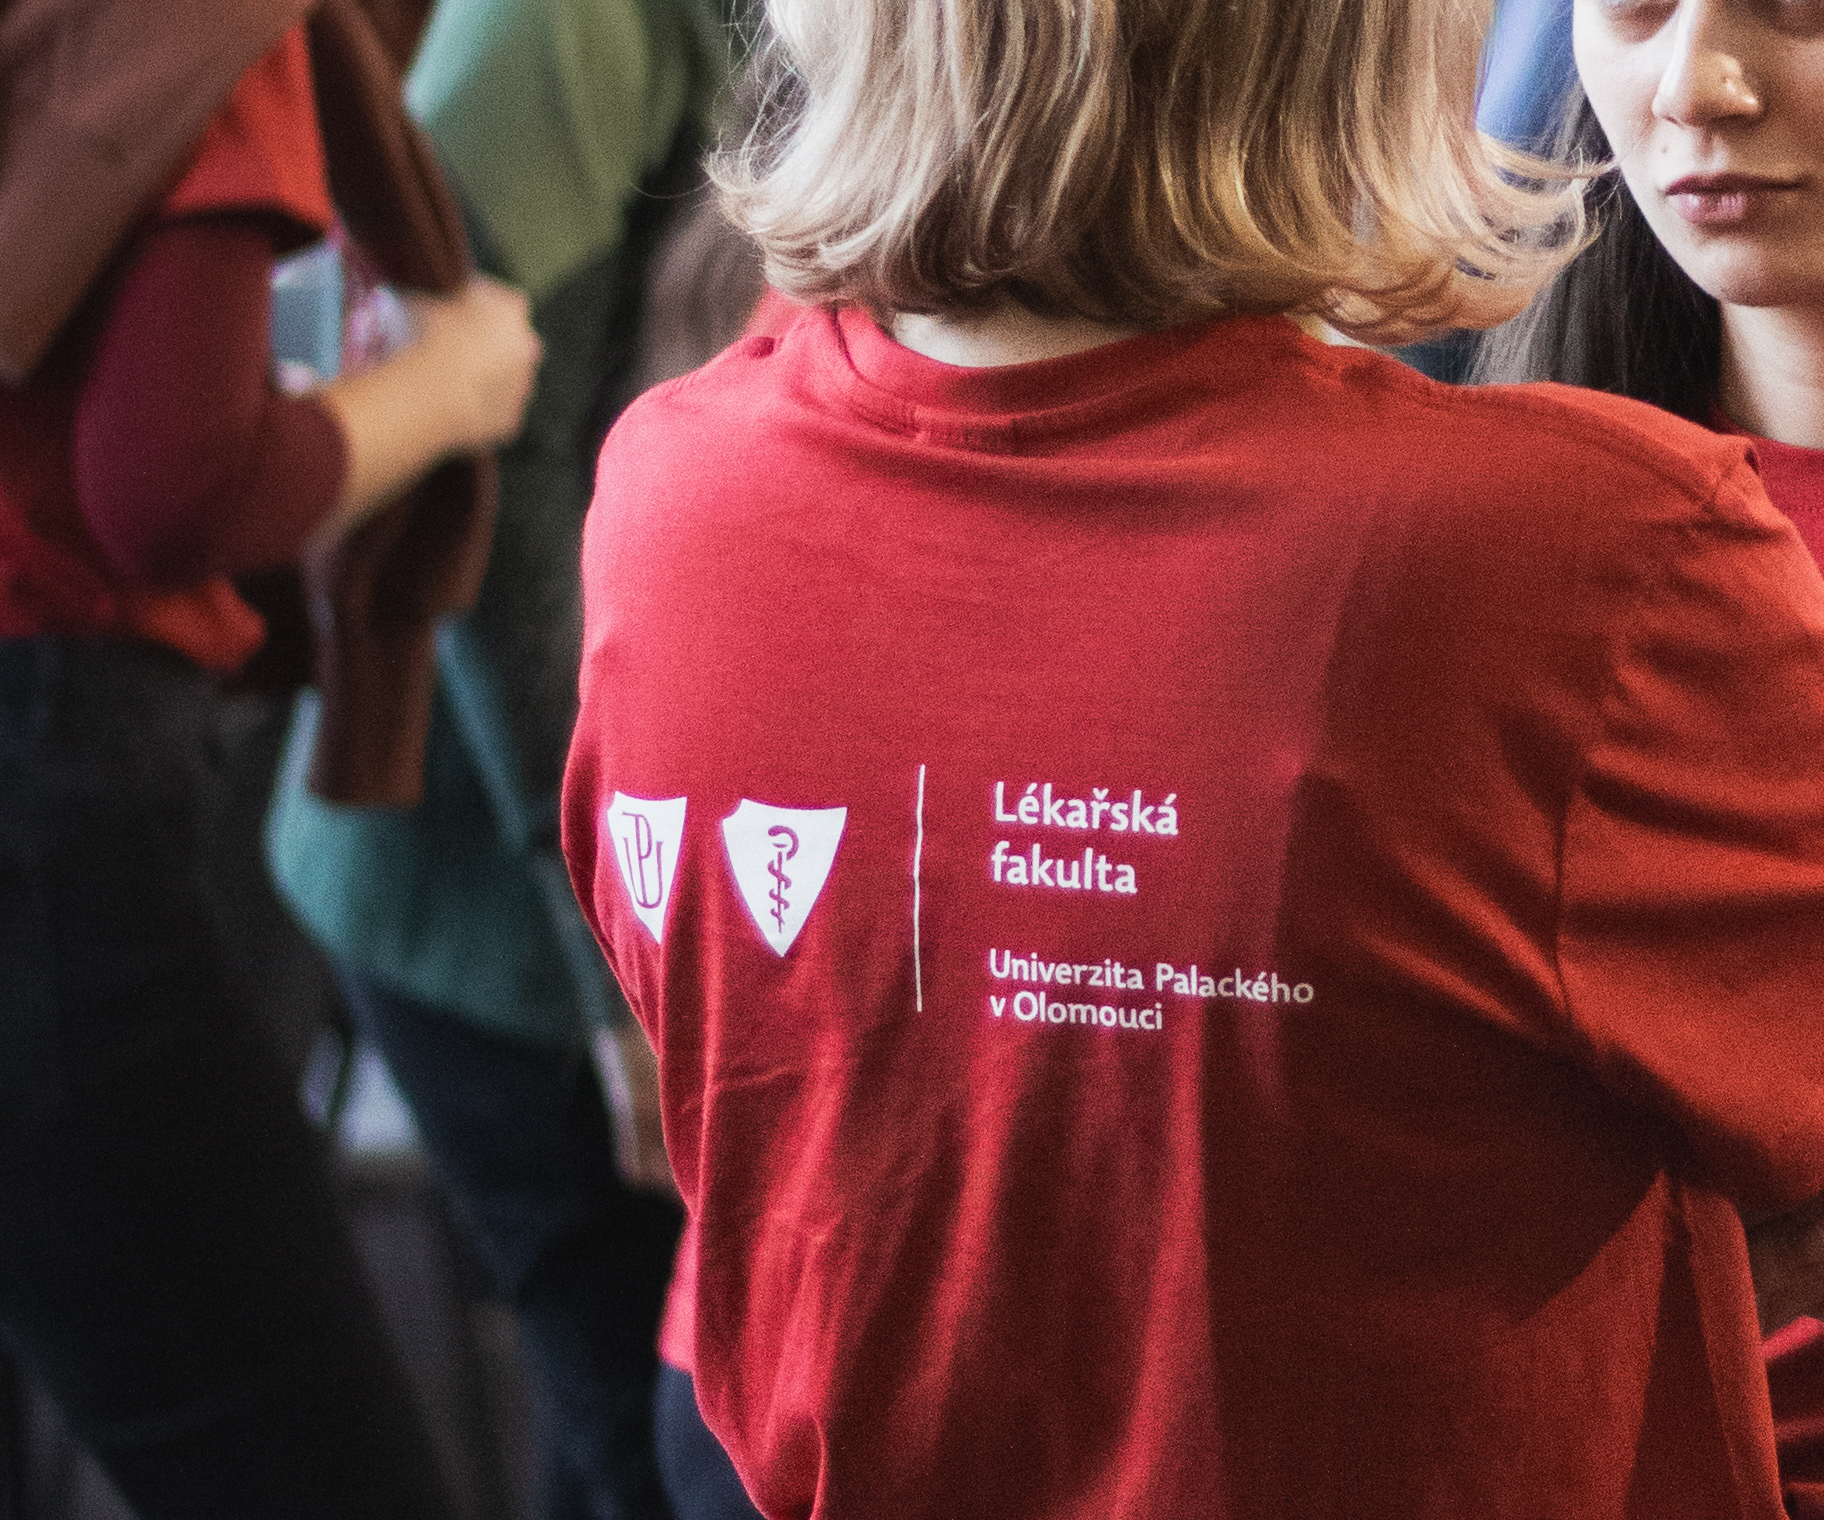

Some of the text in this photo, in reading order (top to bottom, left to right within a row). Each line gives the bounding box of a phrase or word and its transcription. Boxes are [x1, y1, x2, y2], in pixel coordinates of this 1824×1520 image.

[994, 780, 1179, 836] Lékařská
[990, 840, 1138, 895] fakulta
[989, 947, 1315, 1004] Univerzita Palackého
[989, 990, 1163, 1030] v Olomouci
